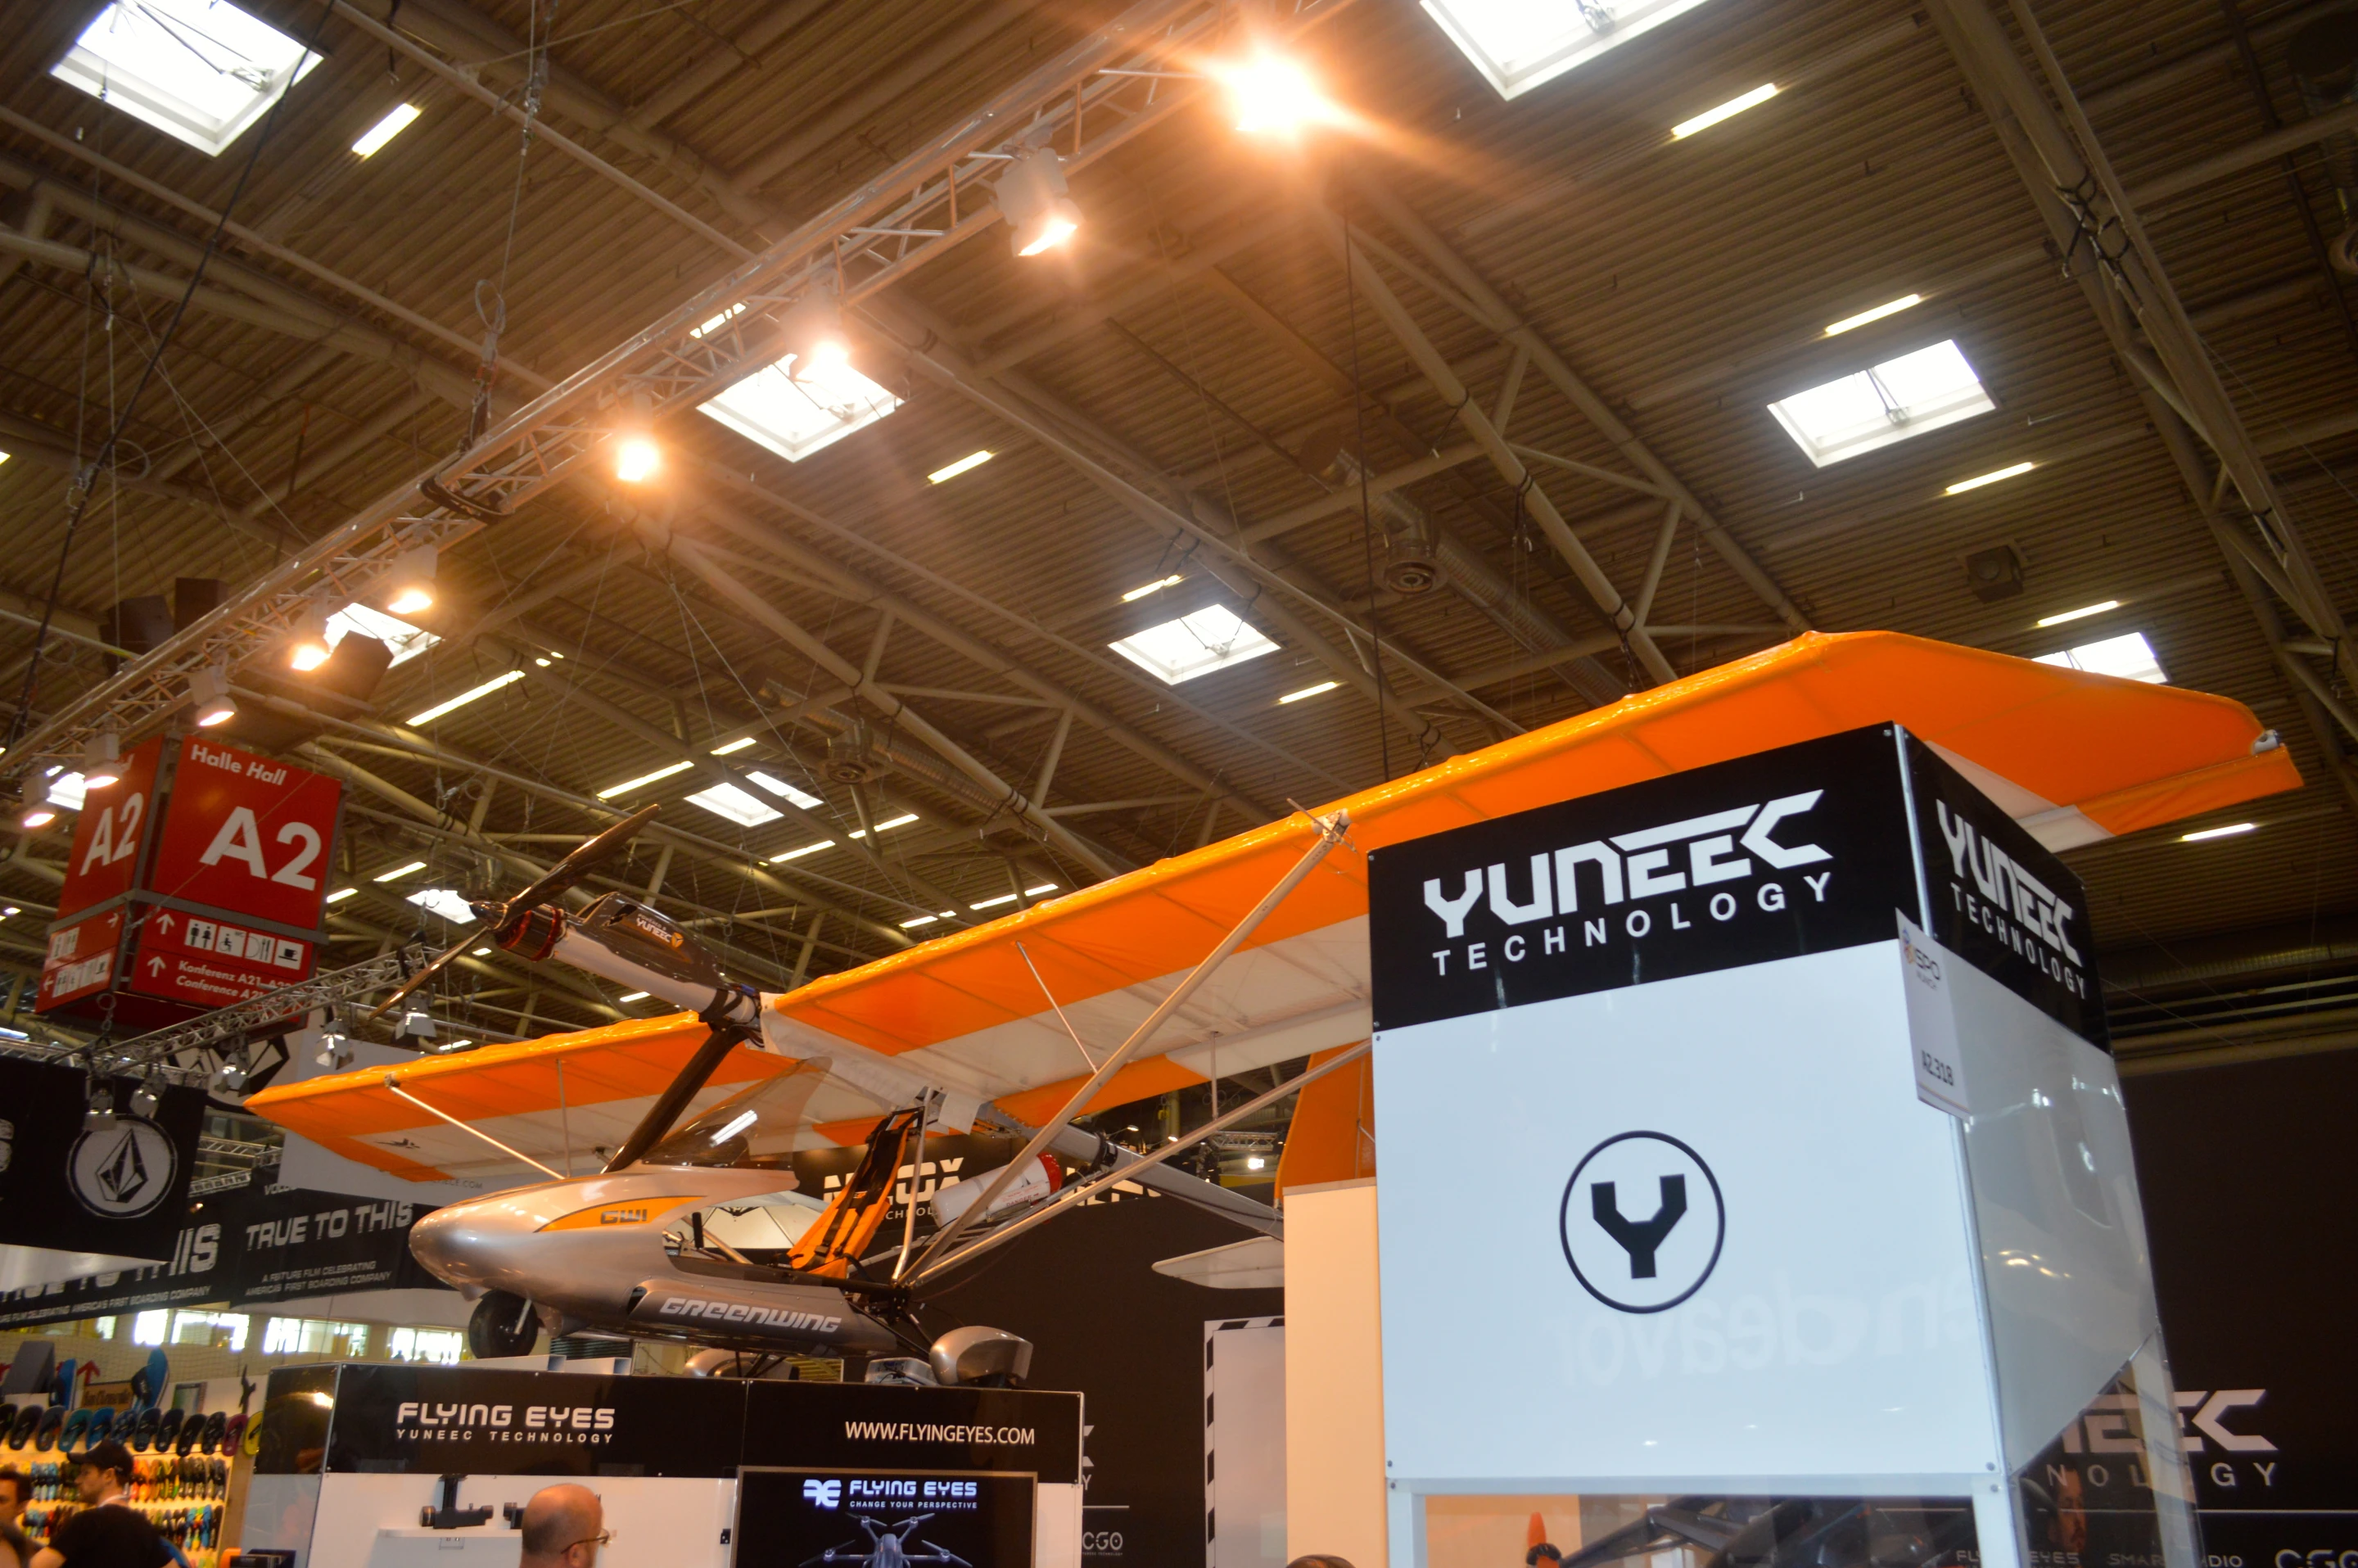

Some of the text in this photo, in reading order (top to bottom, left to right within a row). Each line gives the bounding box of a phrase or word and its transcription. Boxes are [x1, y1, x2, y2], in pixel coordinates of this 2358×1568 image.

[190, 744, 287, 786] Halle Hall
[79, 792, 144, 876] A2
[199, 805, 322, 892] A2
[1424, 789, 1833, 939] YUNEEC
[1936, 798, 2083, 968] YUNEEC
[636, 917, 672, 943] YUNEEC
[1432, 872, 1831, 976] TECHNOLOGY
[1950, 882, 2086, 1000] TECHNOLOGY
[178, 960, 236, 982] Konferenz
[176, 975, 238, 996] Conference
[246, 1200, 413, 1251] TRUE TO THIS
[284, 1281, 307, 1291] FIRST
[308, 1276, 349, 1289] BOARDING
[350, 1271, 393, 1285] COMPANY
[303, 1268, 322, 1279] FILM
[322, 1260, 377, 1275] CELEBRATING
[129, 1290, 169, 1305] BOARDING
[169, 1286, 213, 1300] COMPANY
[397, 1402, 615, 1429] FLYING EYES
[396, 1429, 613, 1444] YUNEEC TECHNOLOGY
[845, 1421, 1035, 1445] WWW.FLYINGEYES.COM
[849, 1480, 978, 1497] FLYING EYES
[1082, 1531, 1123, 1551] CGO
